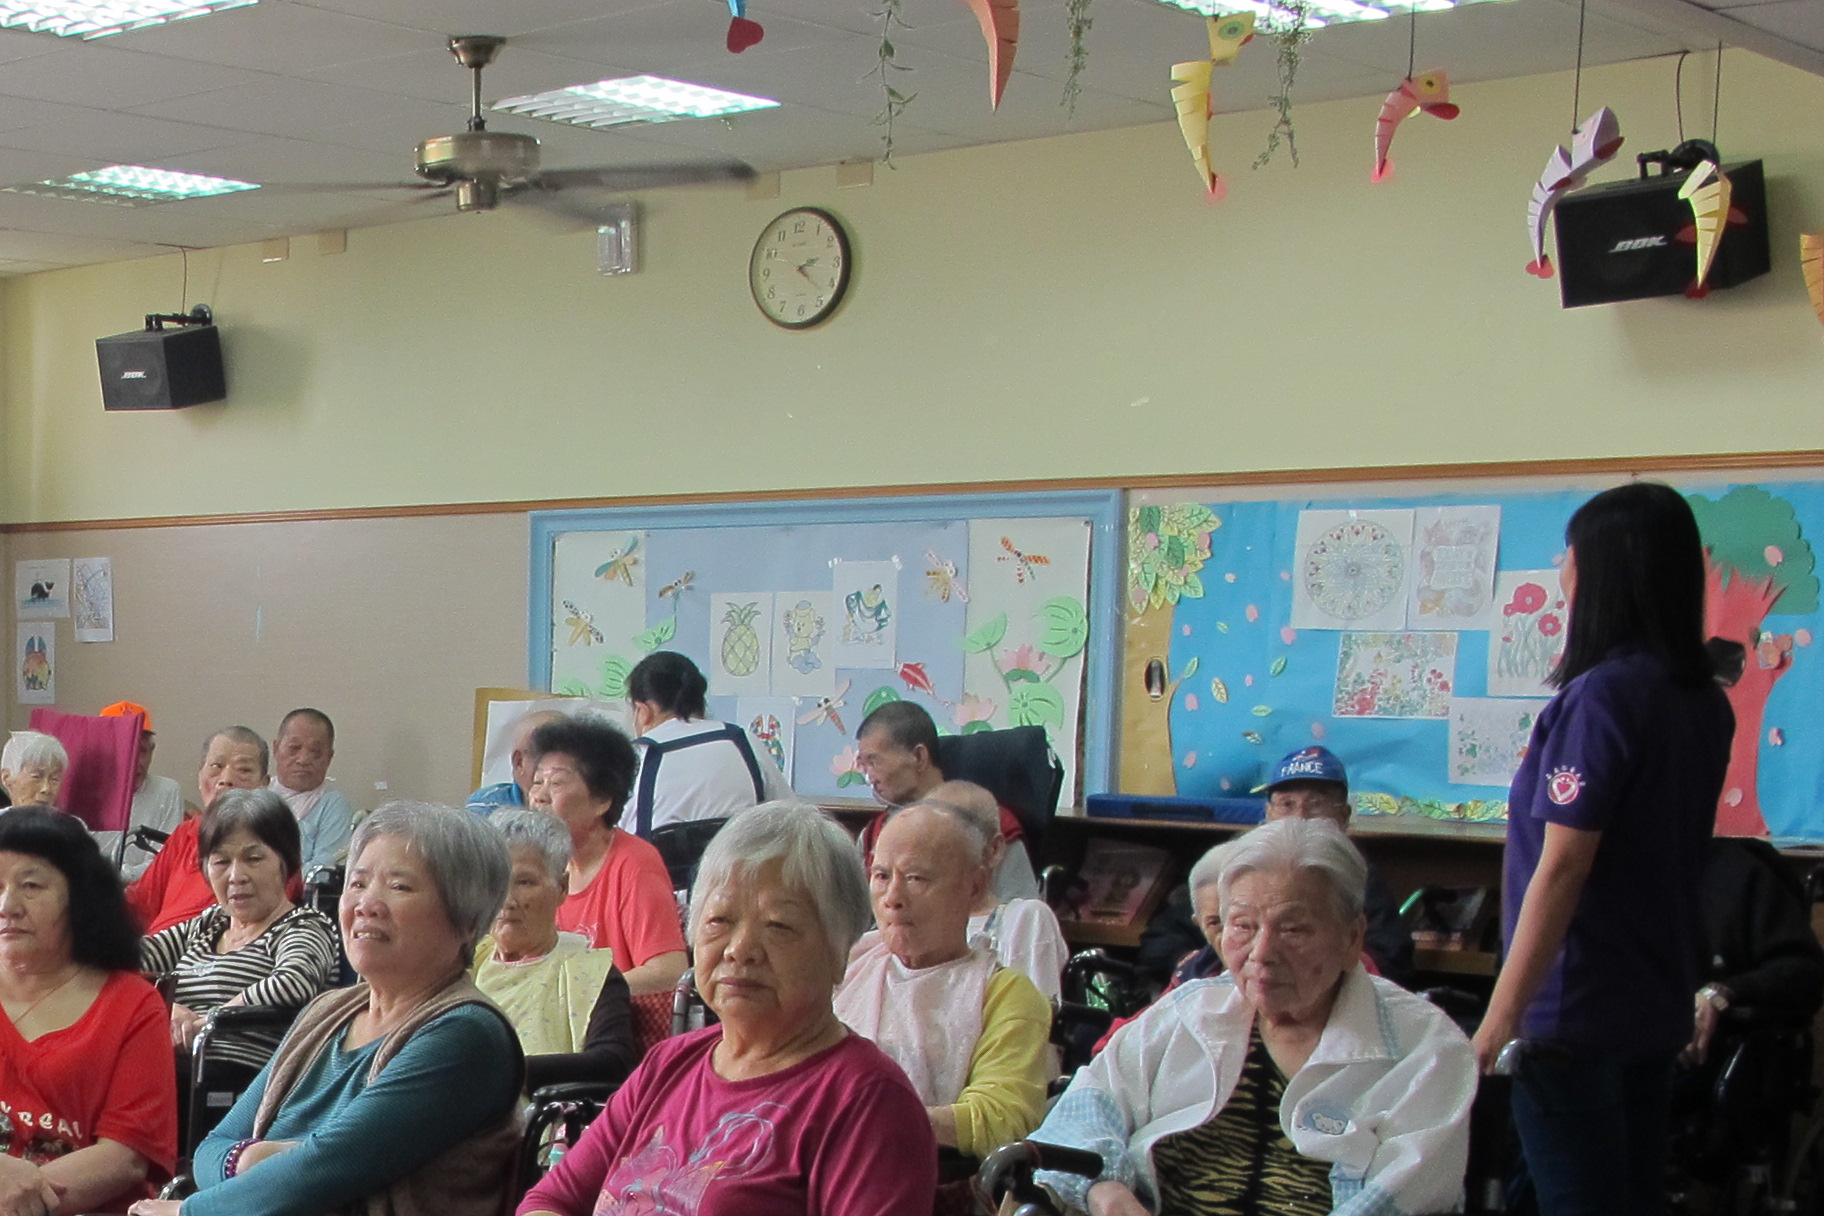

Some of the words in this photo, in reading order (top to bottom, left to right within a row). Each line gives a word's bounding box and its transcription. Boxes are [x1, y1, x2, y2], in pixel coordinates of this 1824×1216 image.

[794, 221, 805, 234] 12
[816, 224, 821, 236] 1
[778, 230, 786, 242] 11
[827, 235, 834, 249] 2
[765, 248, 777, 260] 10
[832, 256, 840, 268] 3
[763, 268, 770, 281] 9
[828, 278, 835, 289] 4
[767, 286, 775, 299] 8
[779, 300, 786, 313] 7
[815, 296, 823, 308] 5
[797, 304, 805, 317] 6
[1280, 761, 1324, 778] FRANCE
